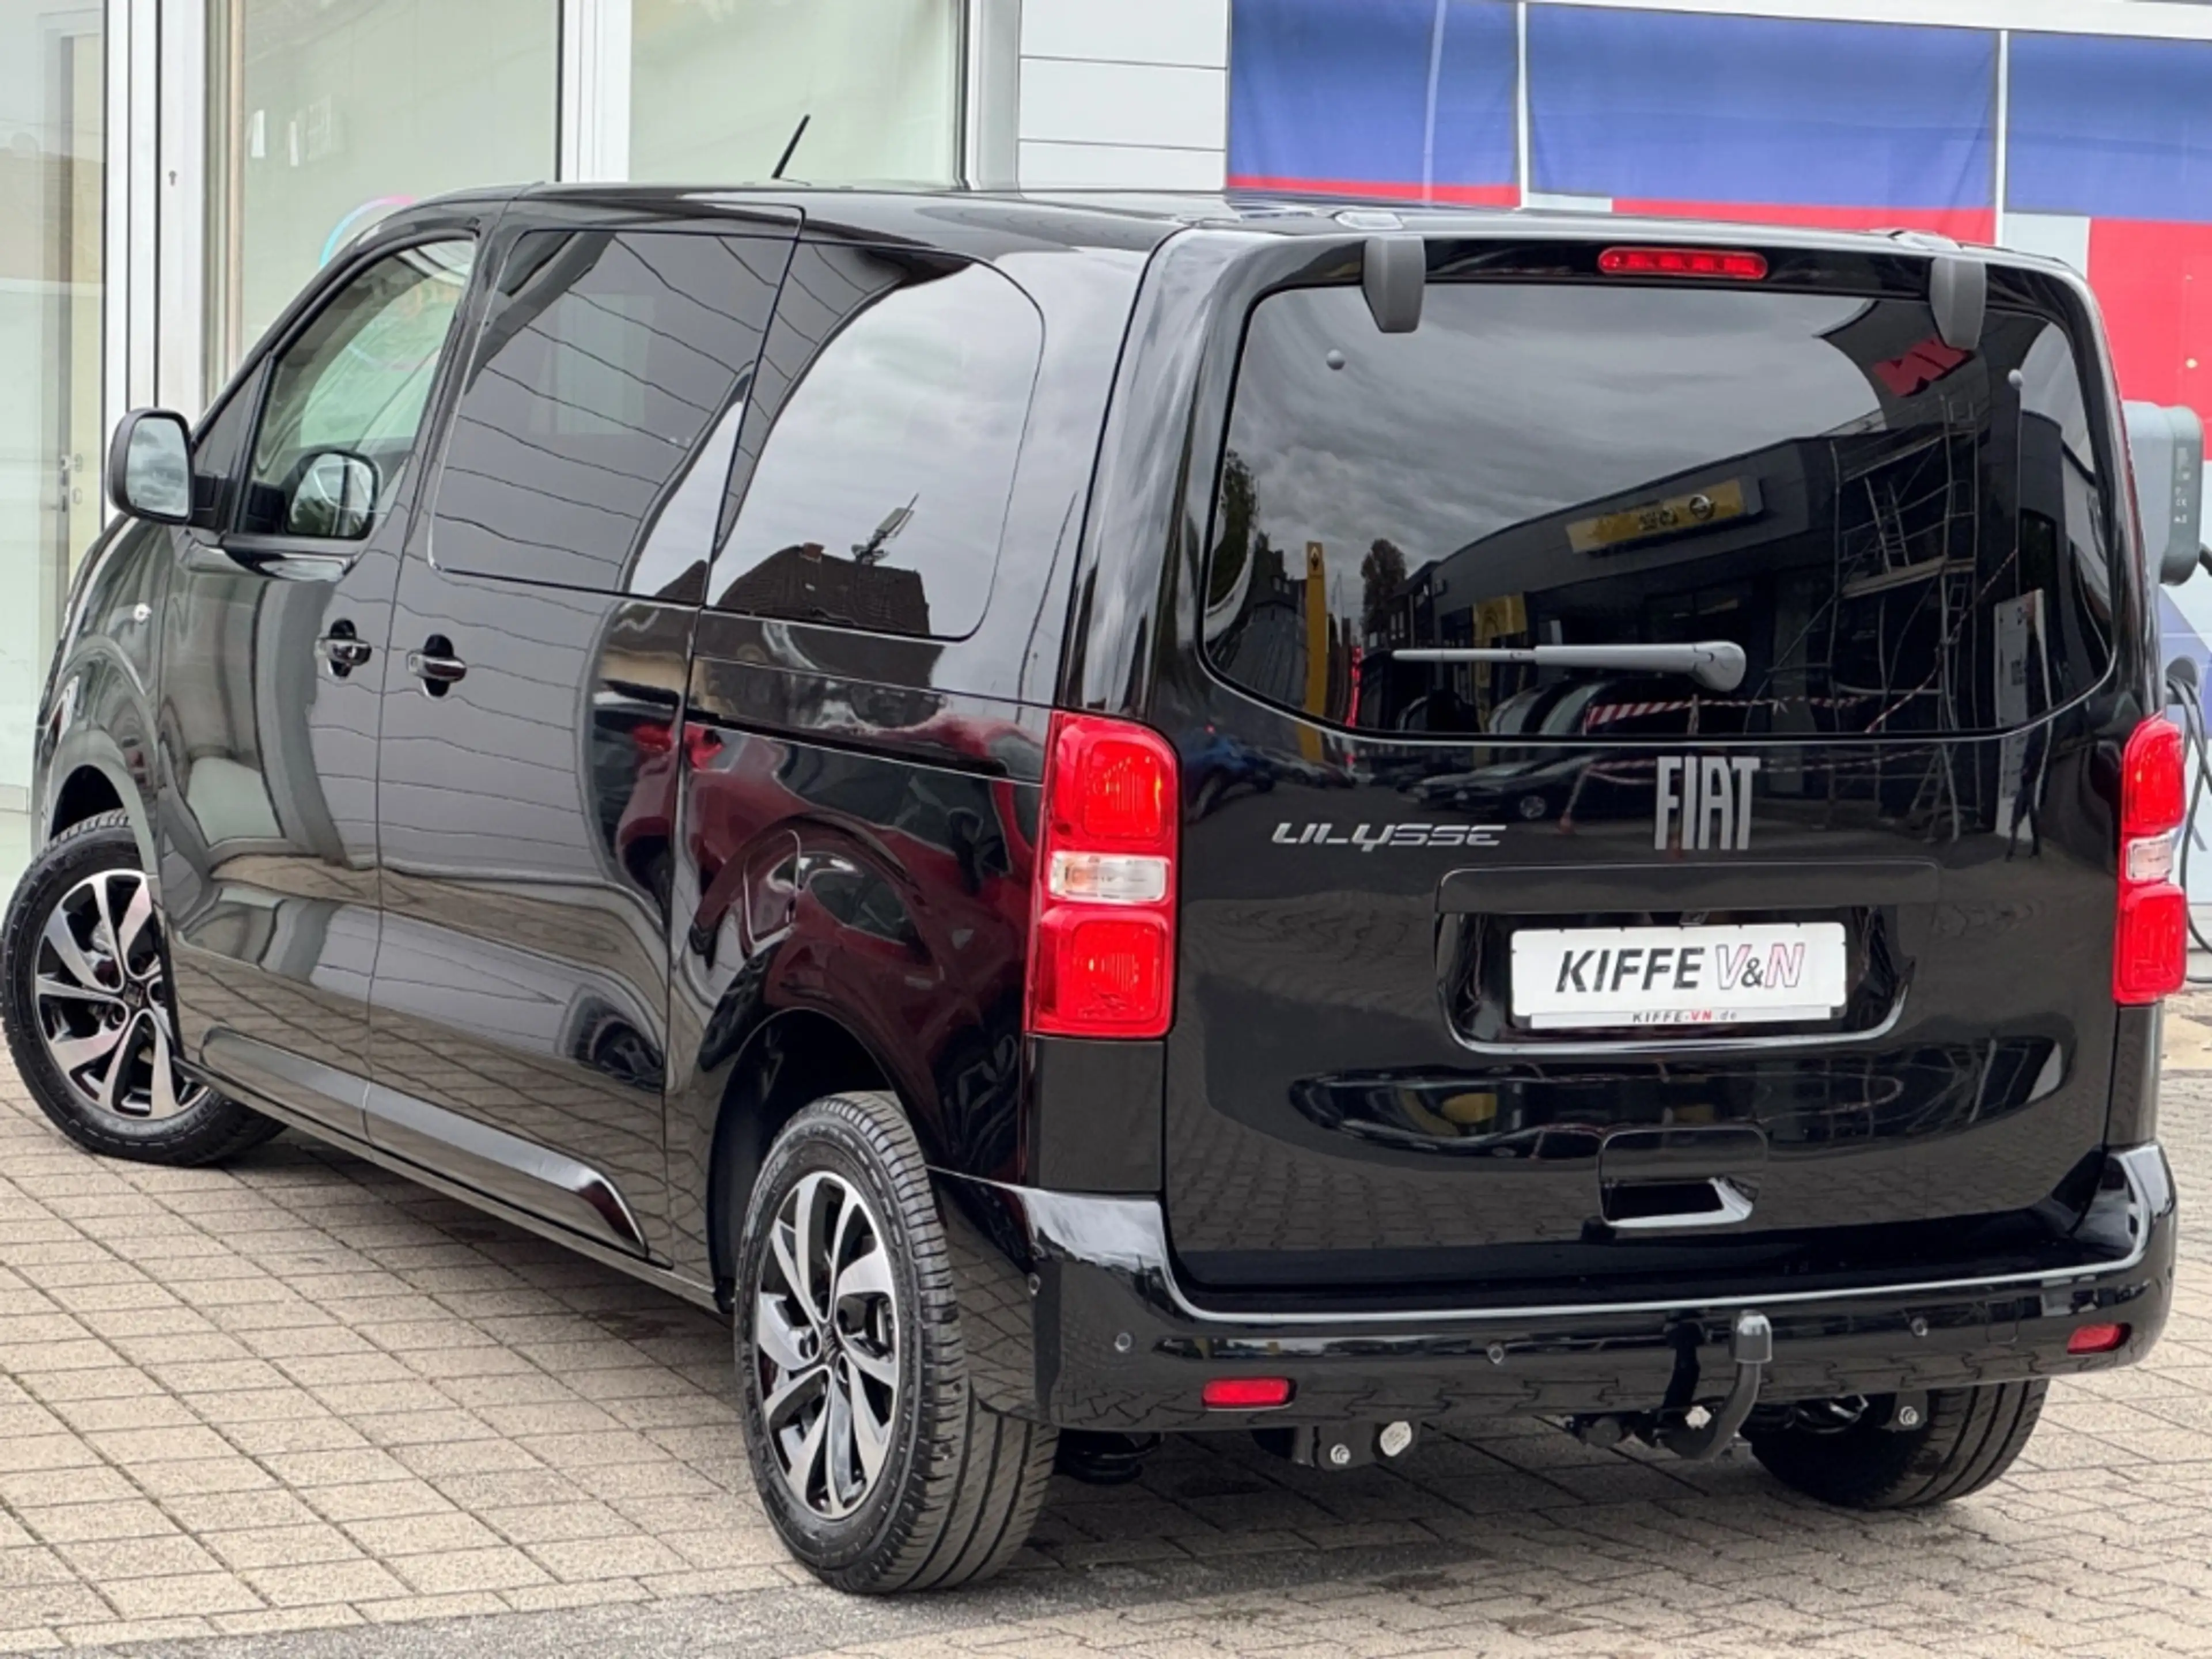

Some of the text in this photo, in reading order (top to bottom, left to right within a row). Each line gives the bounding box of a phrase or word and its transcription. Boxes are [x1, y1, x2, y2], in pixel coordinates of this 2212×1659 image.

[1654, 756, 1760, 850] FIAT
[1271, 823, 1507, 851] ULYSSE
[1555, 942, 1805, 993] KIFFE V&N
